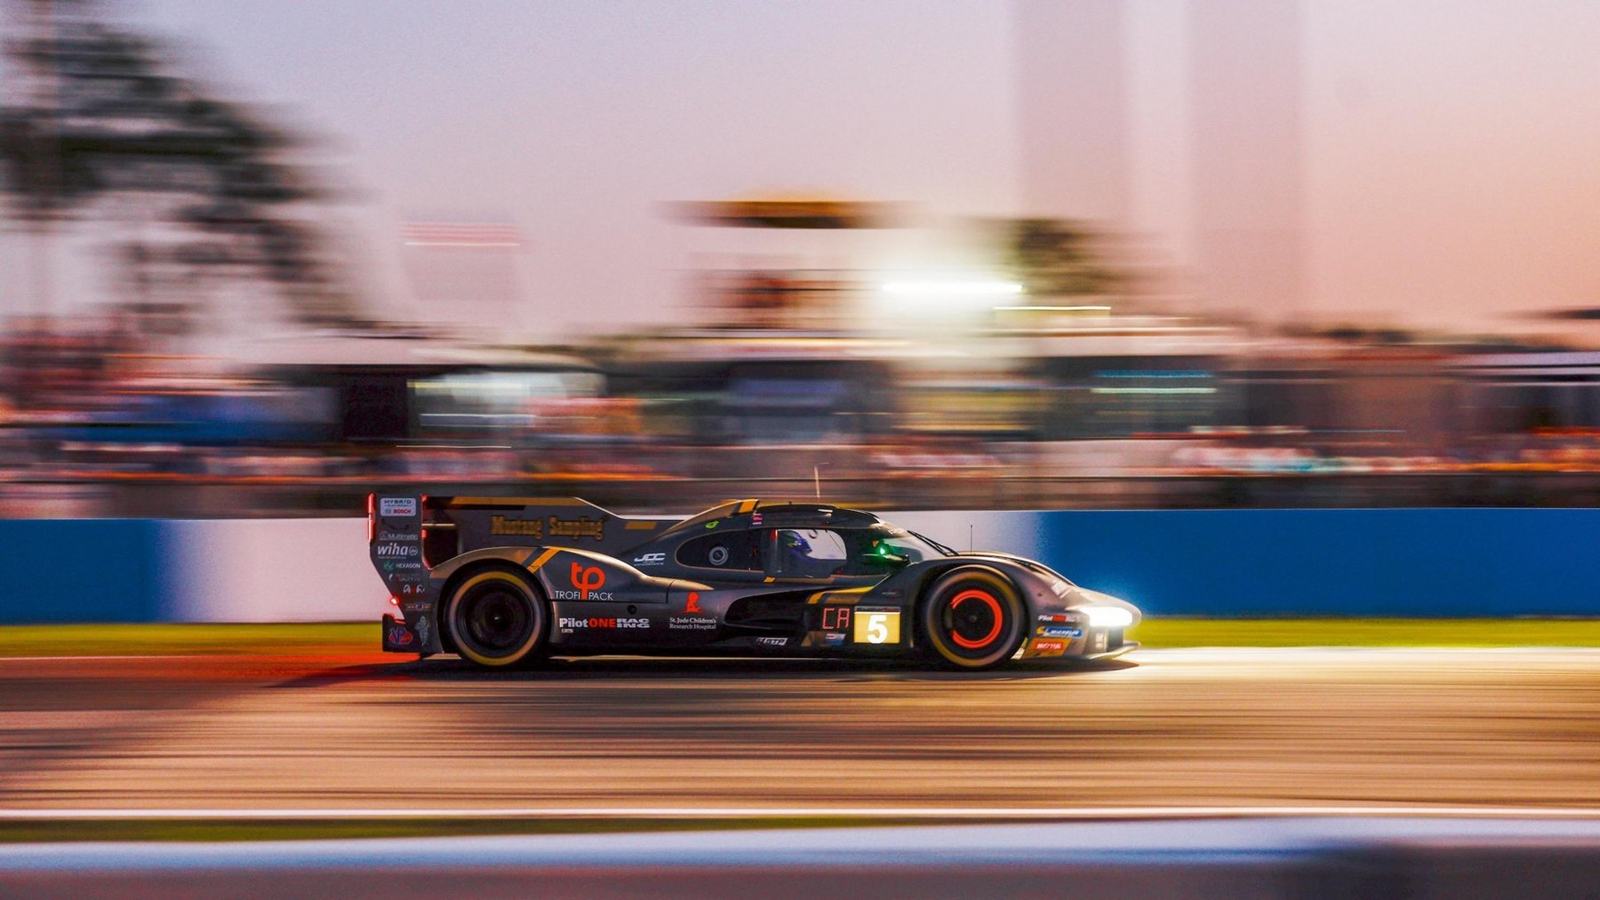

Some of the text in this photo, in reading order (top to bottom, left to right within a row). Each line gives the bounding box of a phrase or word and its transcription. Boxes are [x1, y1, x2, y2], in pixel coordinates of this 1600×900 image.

[491, 515, 604, 540] Mustang Sampling
[377, 542, 408, 555] wiha
[588, 591, 613, 601] PACK
[822, 607, 851, 630] CA
[867, 614, 888, 644] 5
